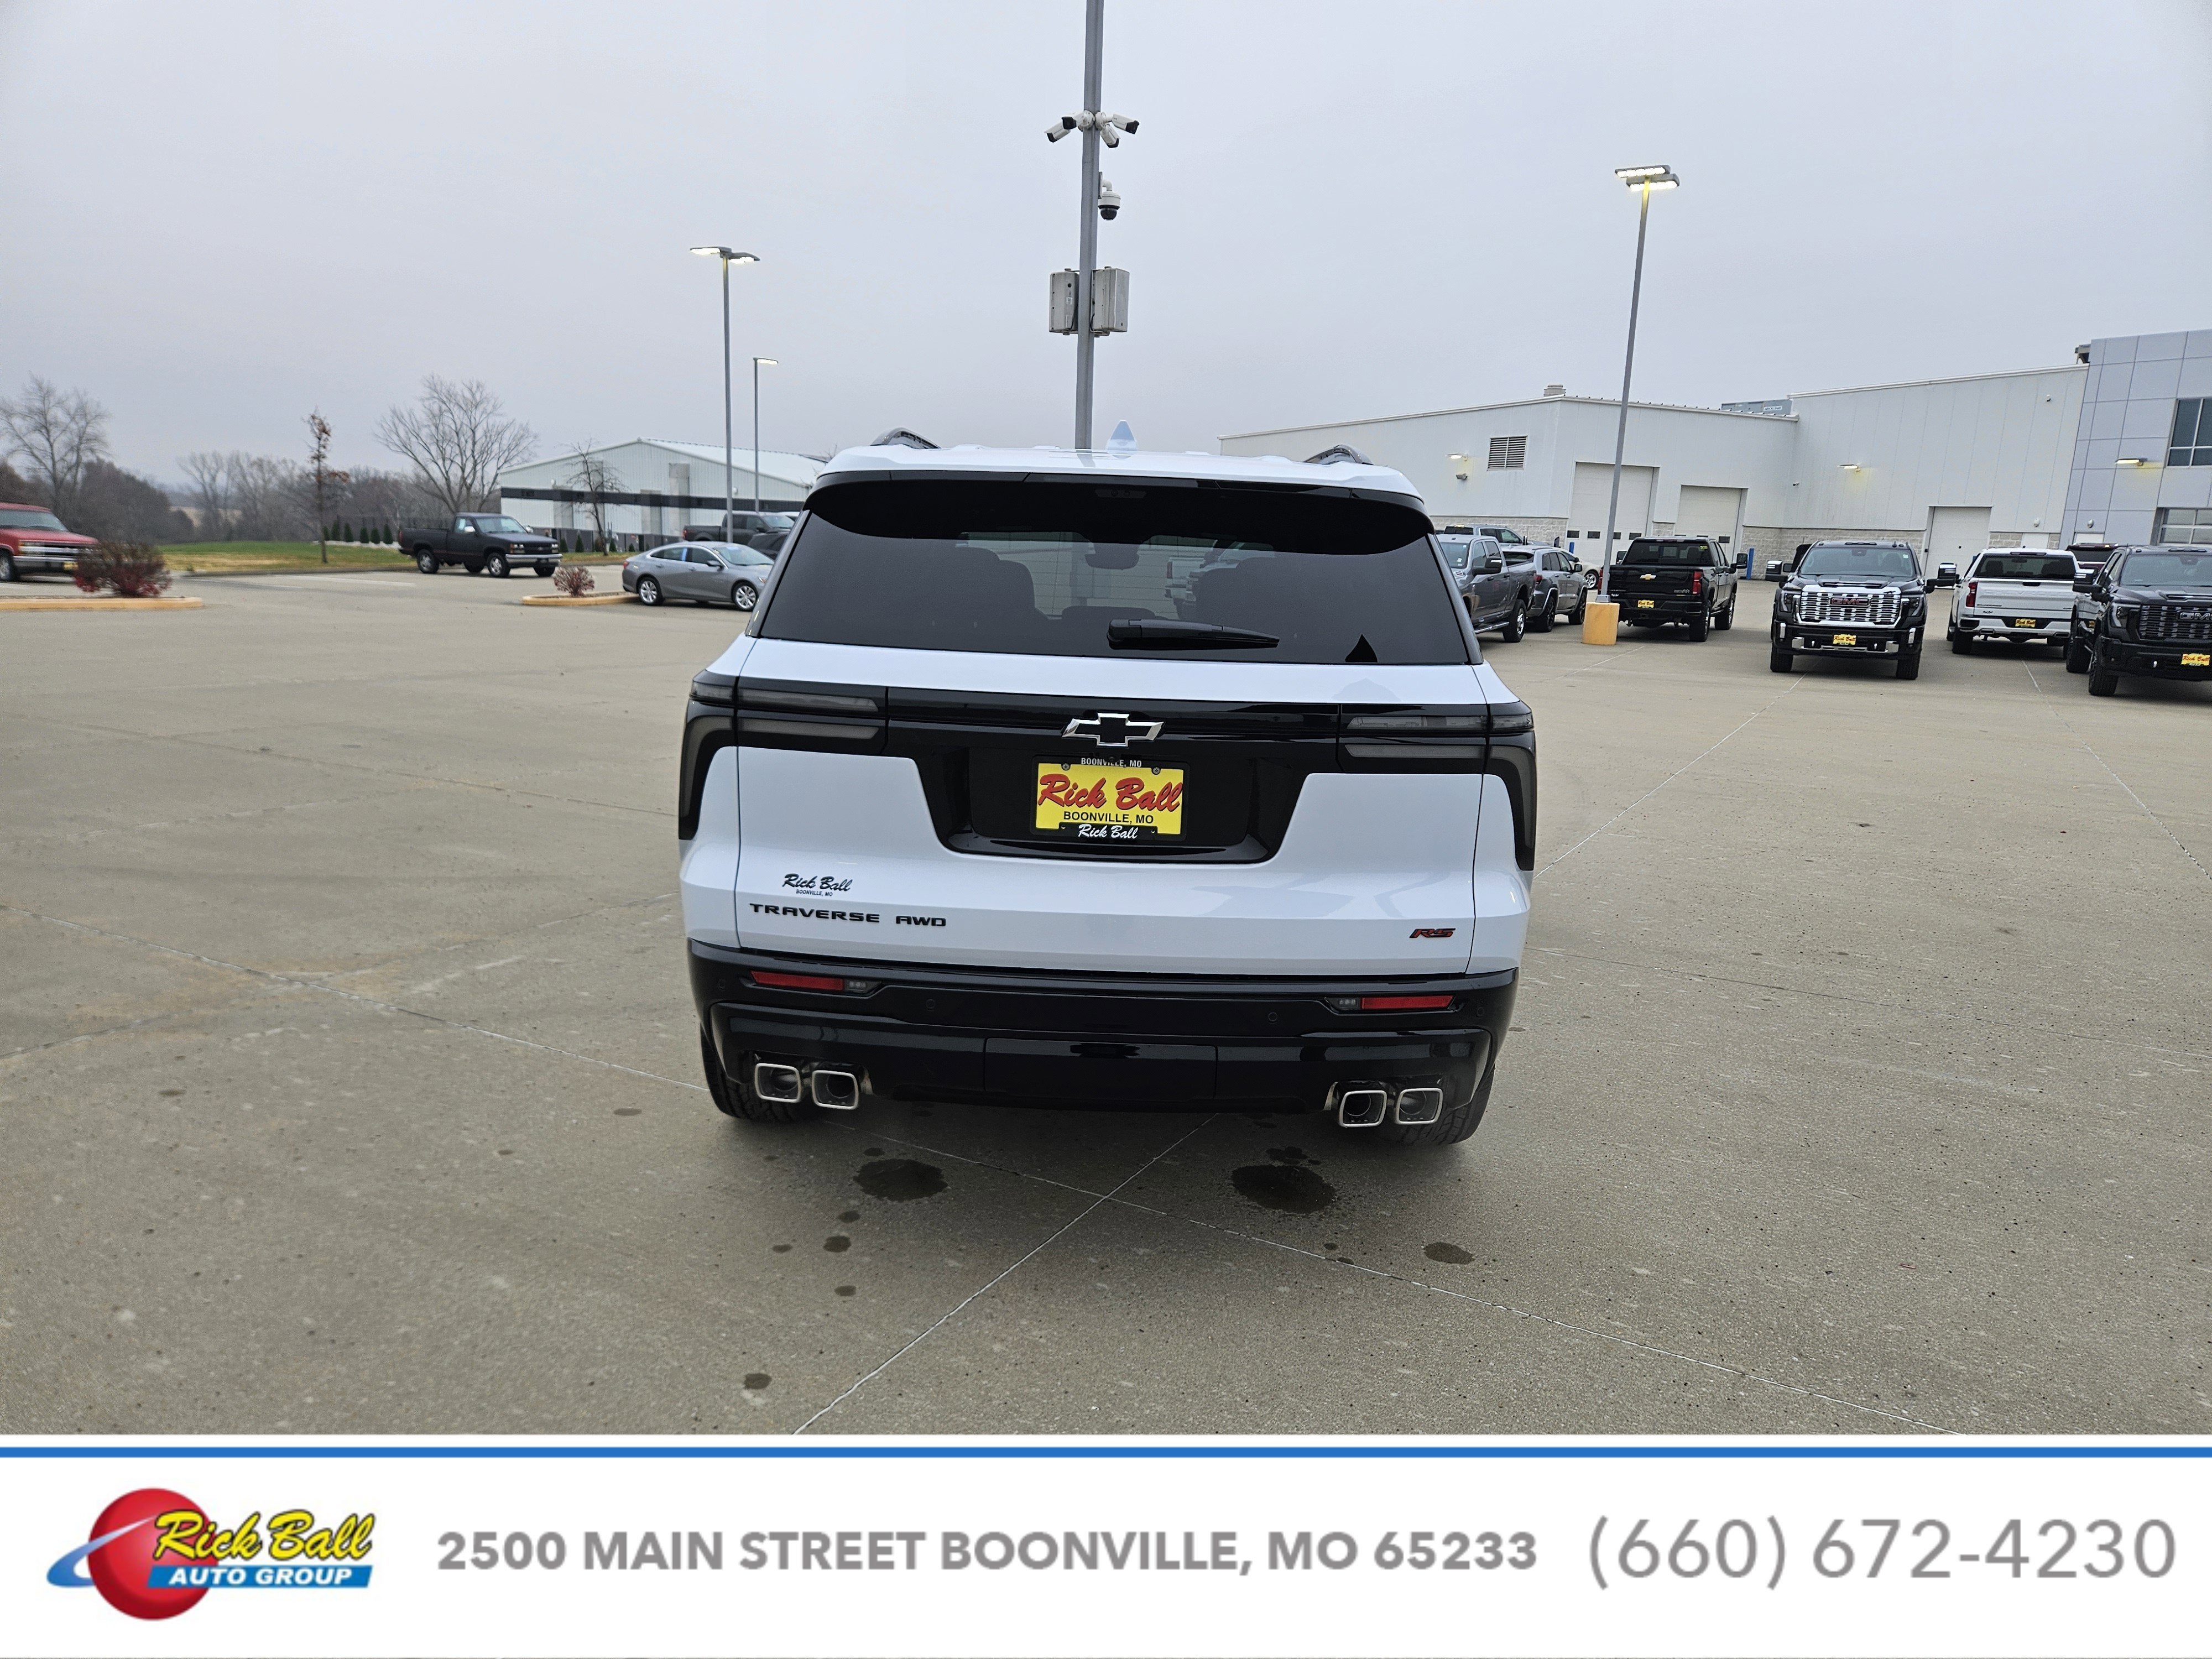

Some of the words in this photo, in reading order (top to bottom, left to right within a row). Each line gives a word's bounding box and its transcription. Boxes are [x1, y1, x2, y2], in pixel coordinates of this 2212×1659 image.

[1038, 773, 1107, 808] Rick
[1115, 777, 1182, 812] Ball
[1063, 811, 1133, 824] BOONVILLE,
[1136, 815, 1154, 824] MO
[1078, 823, 1108, 838] Rick
[1110, 825, 1139, 839] Ball
[782, 873, 817, 889] Rick
[820, 876, 853, 891] Ball
[749, 903, 880, 922] TRAVERSE
[895, 915, 946, 926] AWD
[1409, 928, 1456, 938] RS
